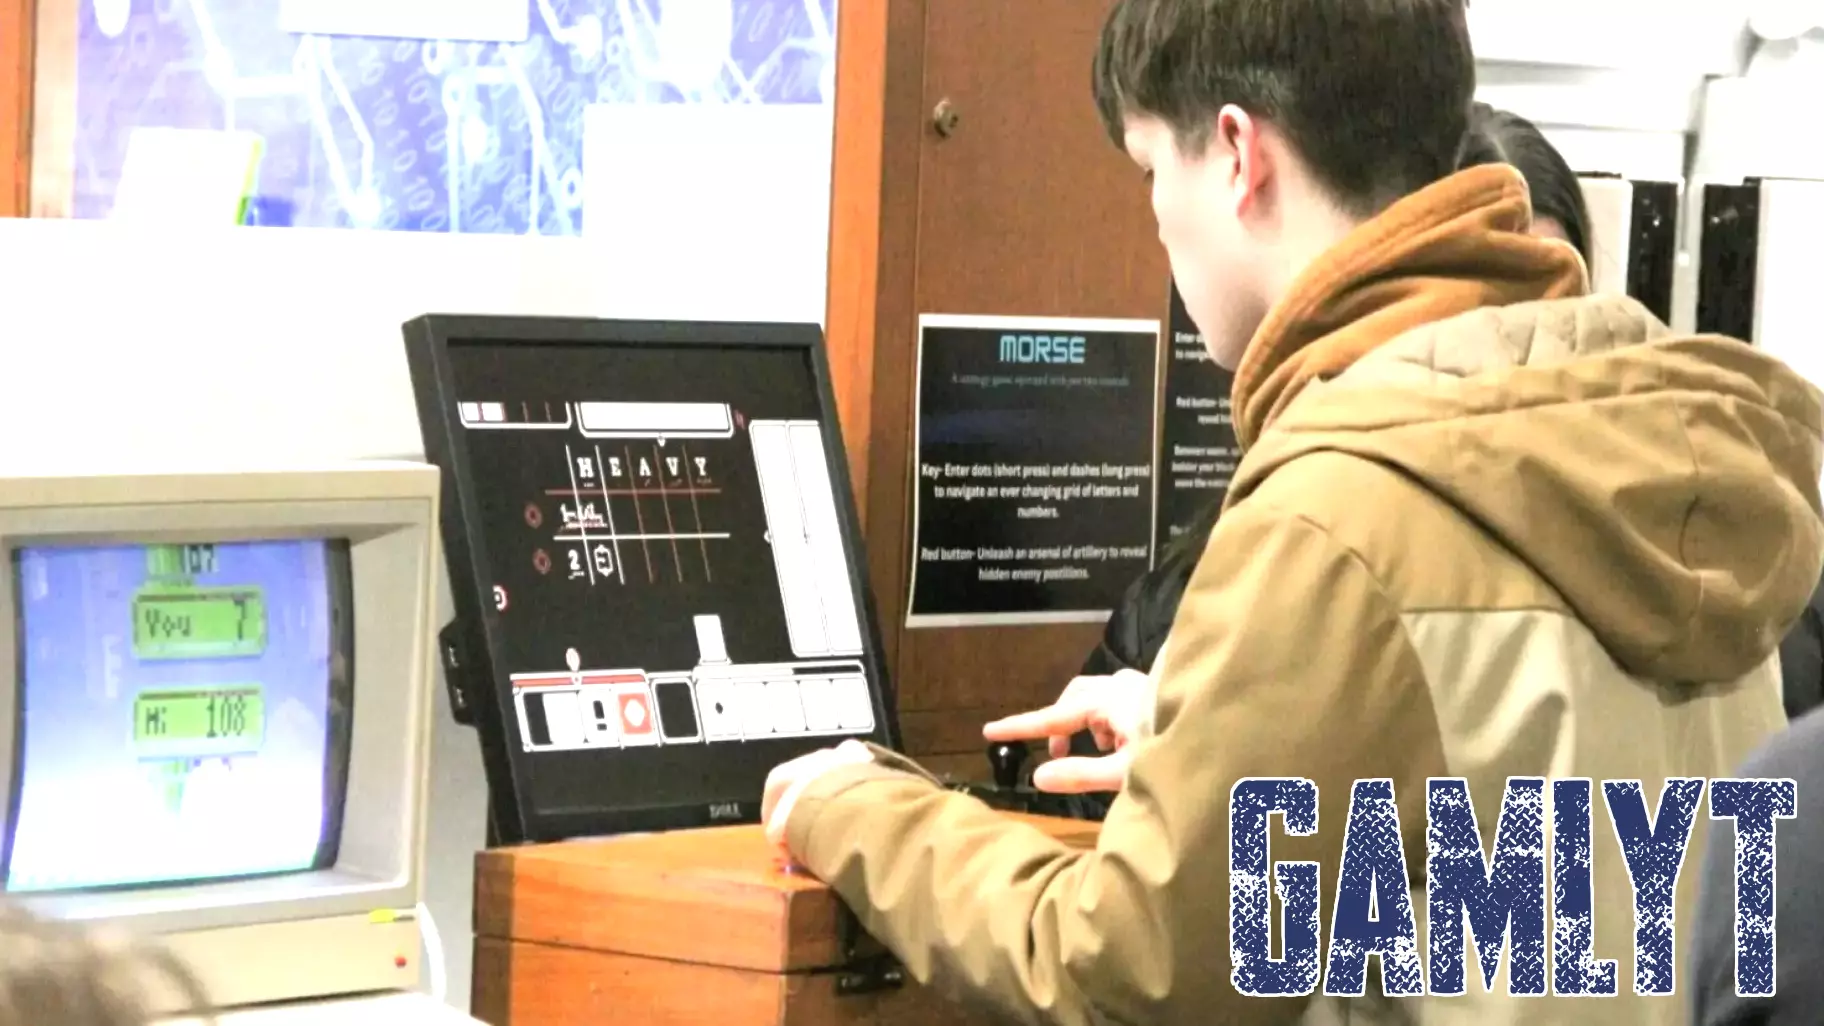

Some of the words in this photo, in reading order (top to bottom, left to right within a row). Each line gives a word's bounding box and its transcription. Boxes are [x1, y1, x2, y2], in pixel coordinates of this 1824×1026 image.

[999, 335, 1086, 364] MORSE
[921, 464, 942, 480] Key-
[945, 464, 970, 477] Enter
[971, 464, 992, 477] dots
[994, 464, 1021, 478] (short
[1023, 464, 1050, 479] press)
[1052, 464, 1068, 477] and
[1070, 464, 1100, 477] dashes
[1101, 463, 1123, 480] (long
[1125, 464, 1150, 479] press)
[934, 485, 944, 498] to
[946, 485, 985, 501] navigate
[987, 487, 998, 498] an
[1000, 487, 1020, 498] ever
[1022, 485, 1062, 500] changing
[1063, 484, 1080, 500] grid
[1082, 484, 1092, 498] of
[1093, 485, 1121, 498] letters
[1123, 485, 1139, 498] and
[1017, 505, 1060, 519] numbers.
[568, 549, 581, 570] 2
[921, 547, 940, 561] Red
[941, 547, 976, 561] button-
[977, 547, 1013, 560] Unleash
[1015, 549, 1027, 560] an
[1028, 547, 1060, 560] arsenal
[1062, 546, 1073, 559] of
[1073, 545, 1107, 562] artillery
[1108, 546, 1119, 559] to
[1120, 545, 1148, 558] reveal
[978, 566, 1010, 581] hidden
[1012, 568, 1041, 583] enemy
[145, 608, 191, 639] You
[233, 597, 248, 641] 7
[145, 706, 167, 736] Hi
[205, 694, 247, 739] 108
